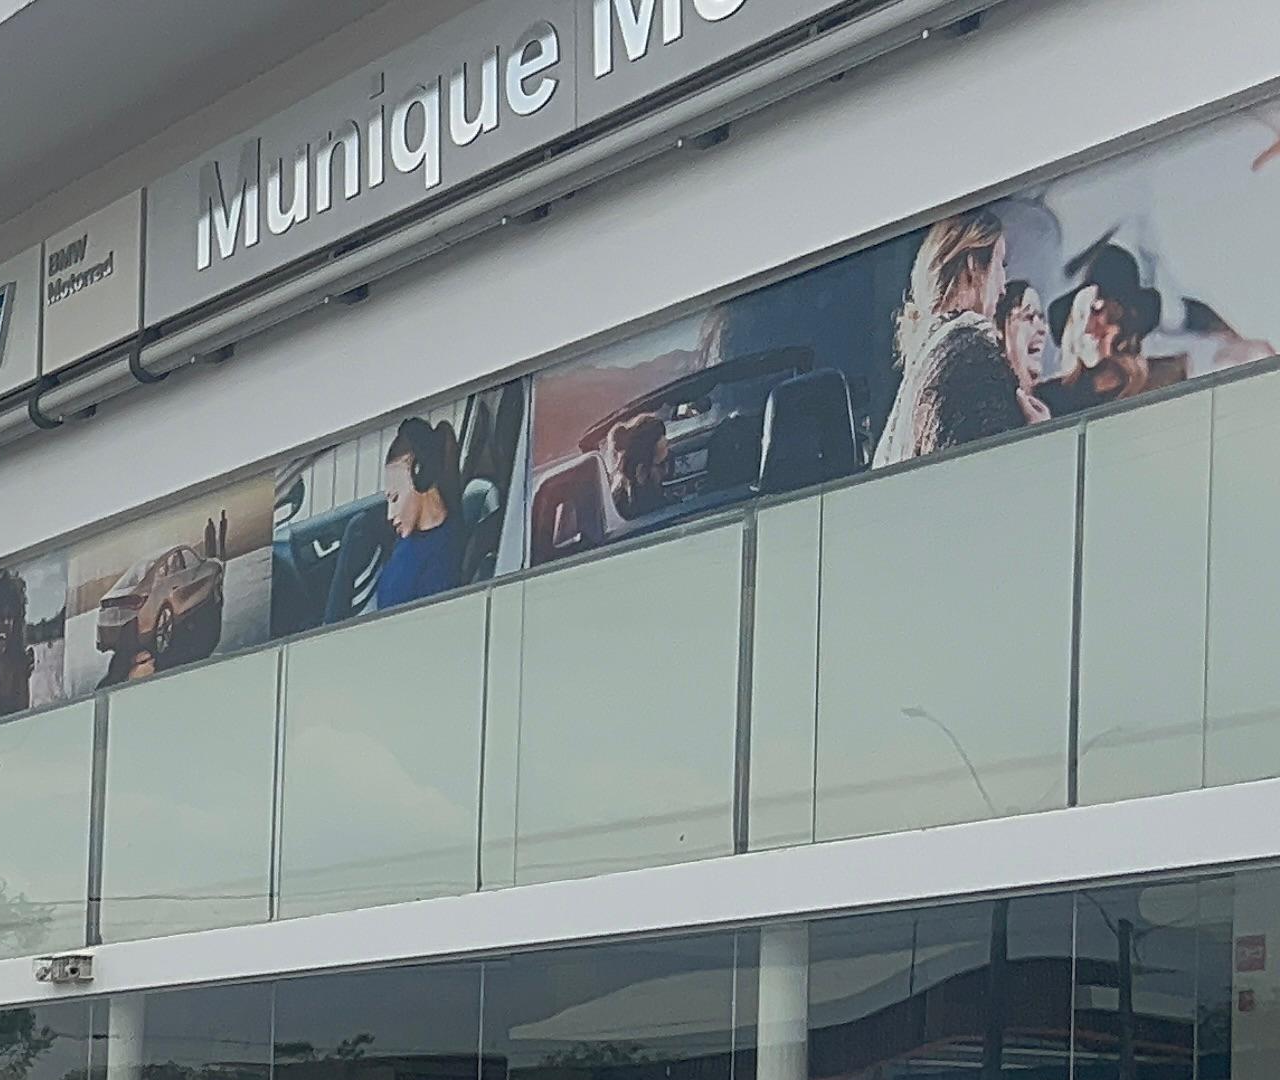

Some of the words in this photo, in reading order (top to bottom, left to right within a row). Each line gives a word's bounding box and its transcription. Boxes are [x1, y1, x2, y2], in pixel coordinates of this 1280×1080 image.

[197, 20, 561, 272] Munique
[47, 233, 88, 277] BMW
[47, 251, 115, 308] Motorrad
